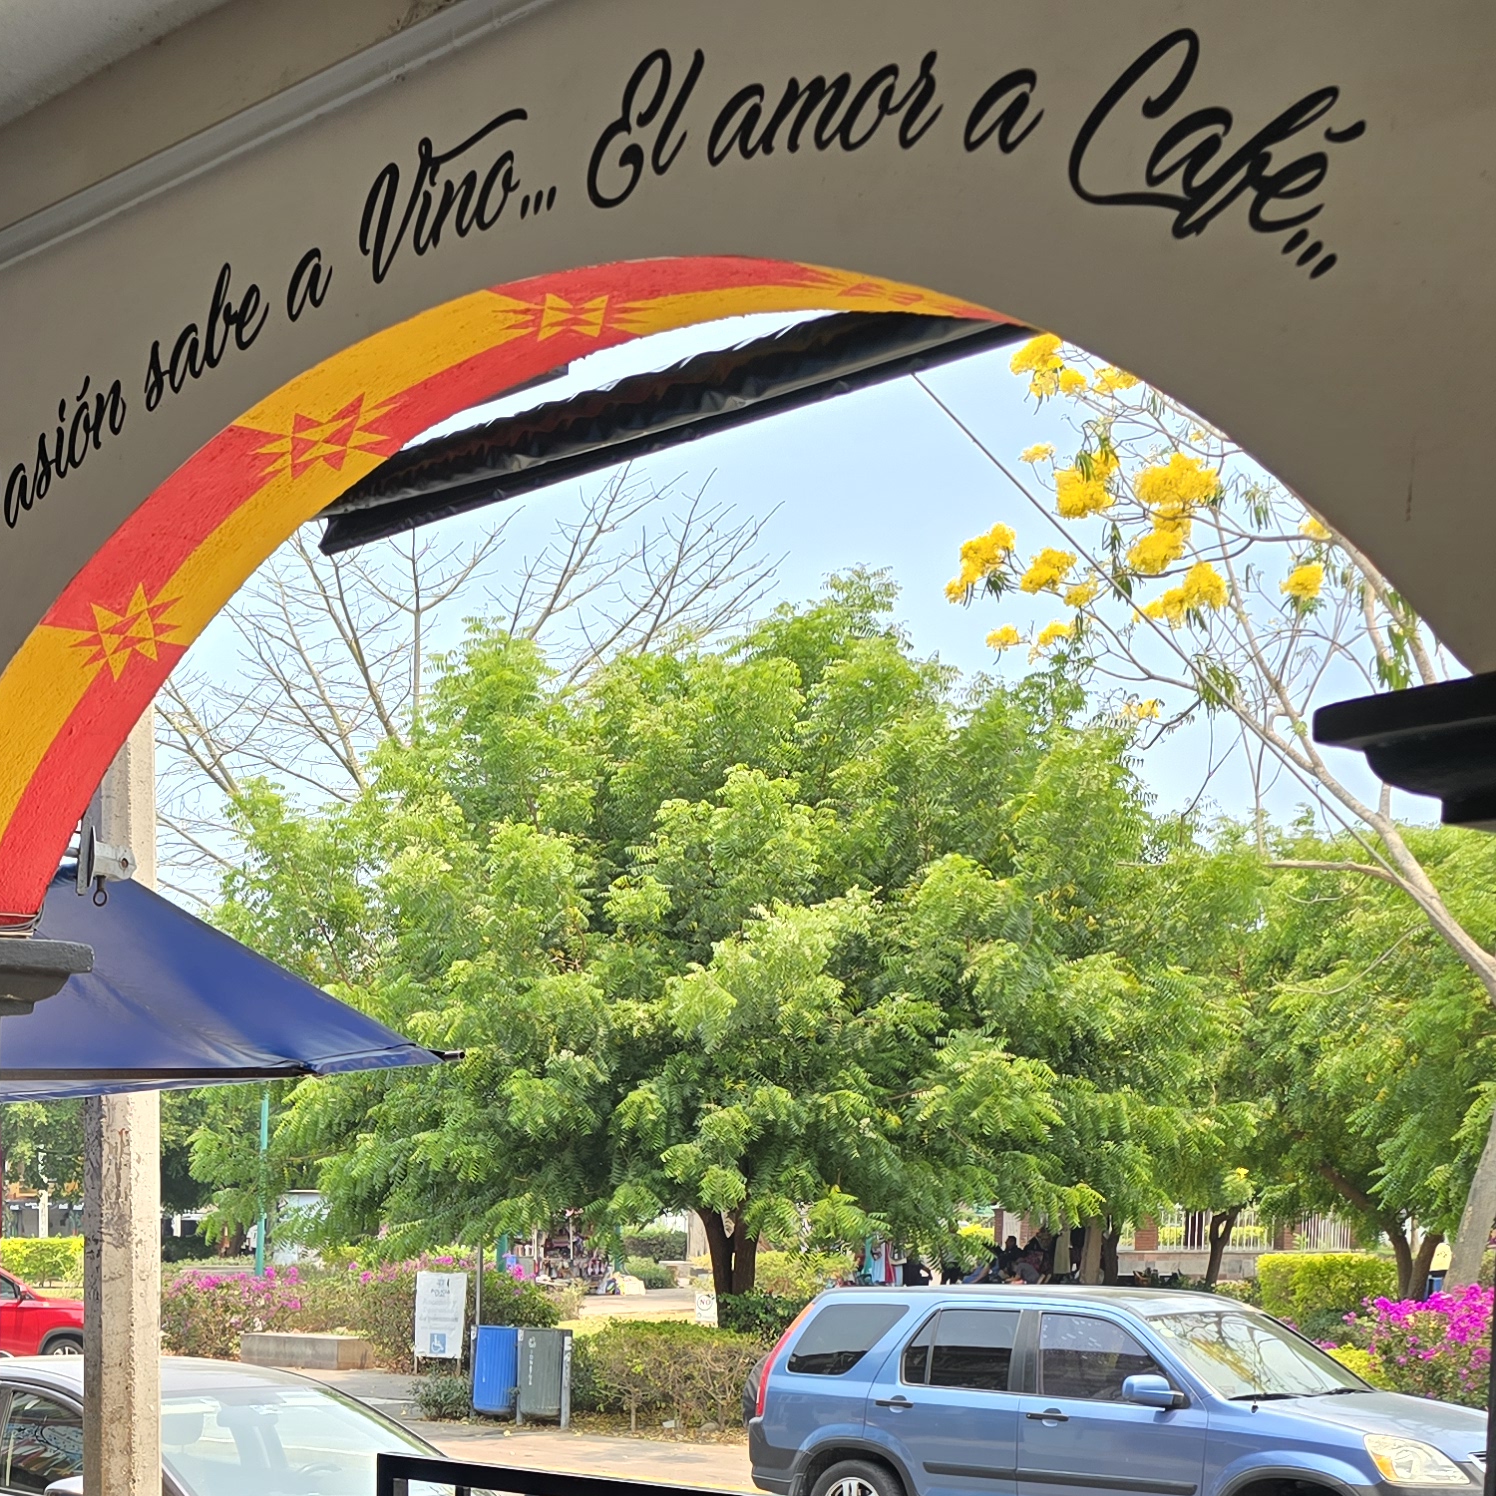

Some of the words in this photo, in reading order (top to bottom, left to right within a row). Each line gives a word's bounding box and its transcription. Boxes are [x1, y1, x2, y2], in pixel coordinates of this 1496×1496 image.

[145, 262, 270, 413] sabe
[286, 246, 333, 322] a
[359, 108, 558, 285] Vino...
[587, 48, 705, 210] El
[707, 51, 944, 168] amor
[964, 68, 1045, 155] a
[1068, 28, 1366, 280] Café...
